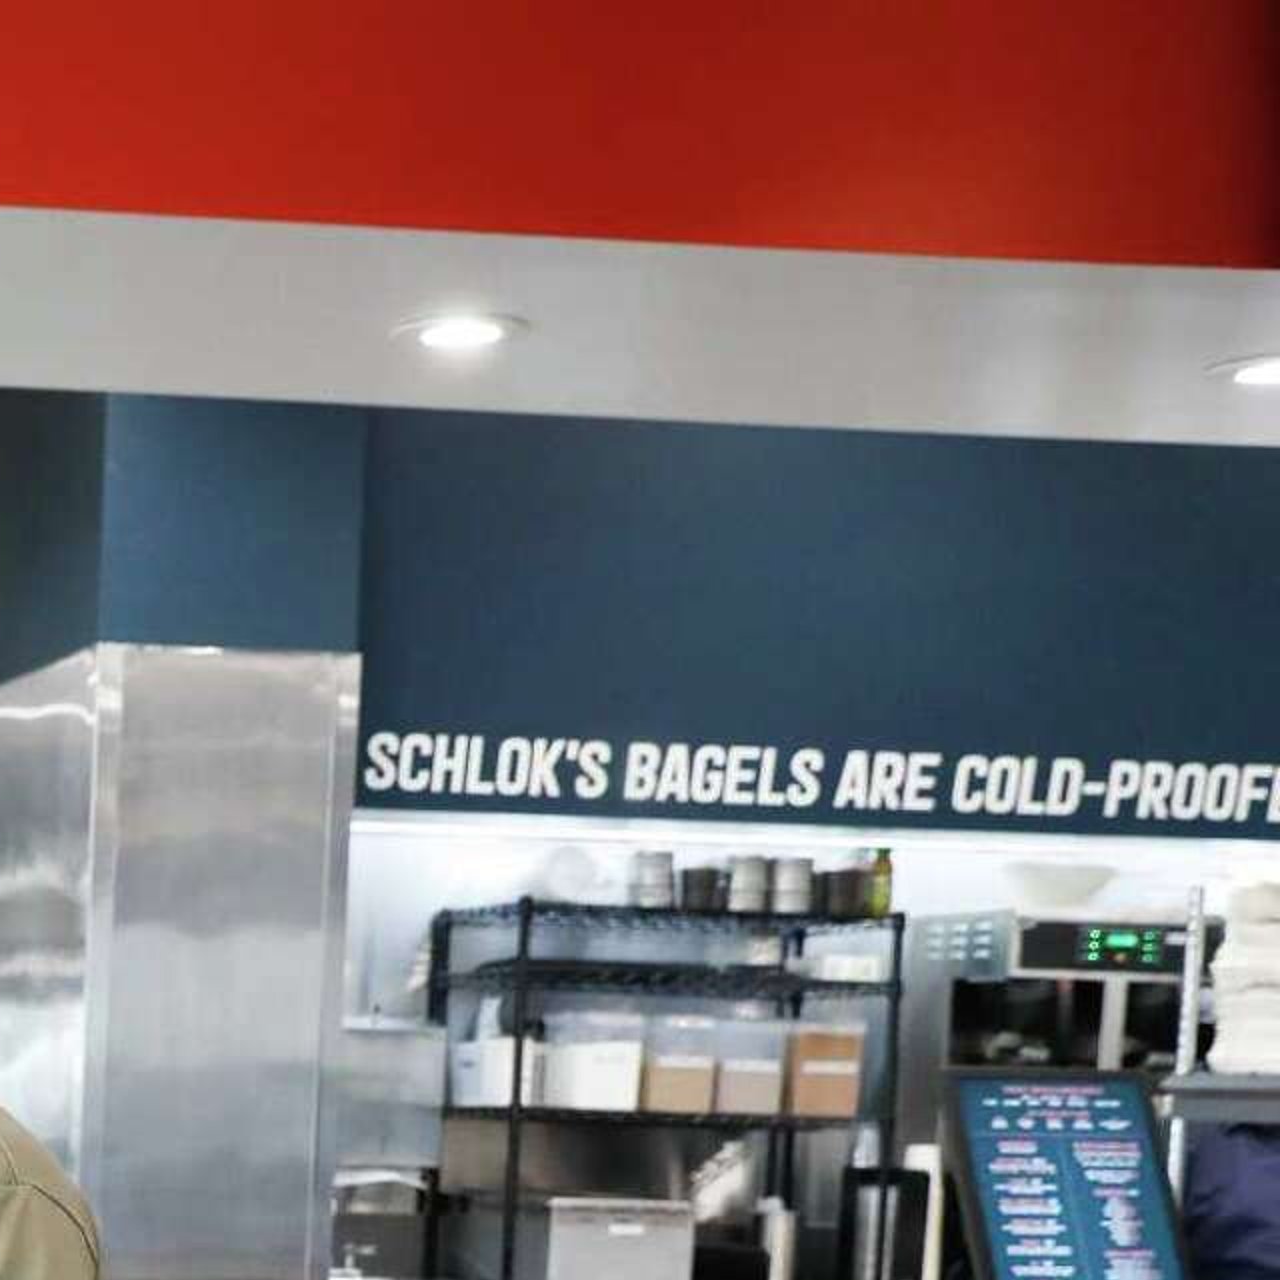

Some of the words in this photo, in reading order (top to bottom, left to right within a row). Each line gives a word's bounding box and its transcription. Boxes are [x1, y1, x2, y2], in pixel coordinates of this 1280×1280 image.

[364, 732, 612, 799] SCHLOK'S
[624, 742, 826, 807] BAGELS
[833, 749, 942, 812] ARE
